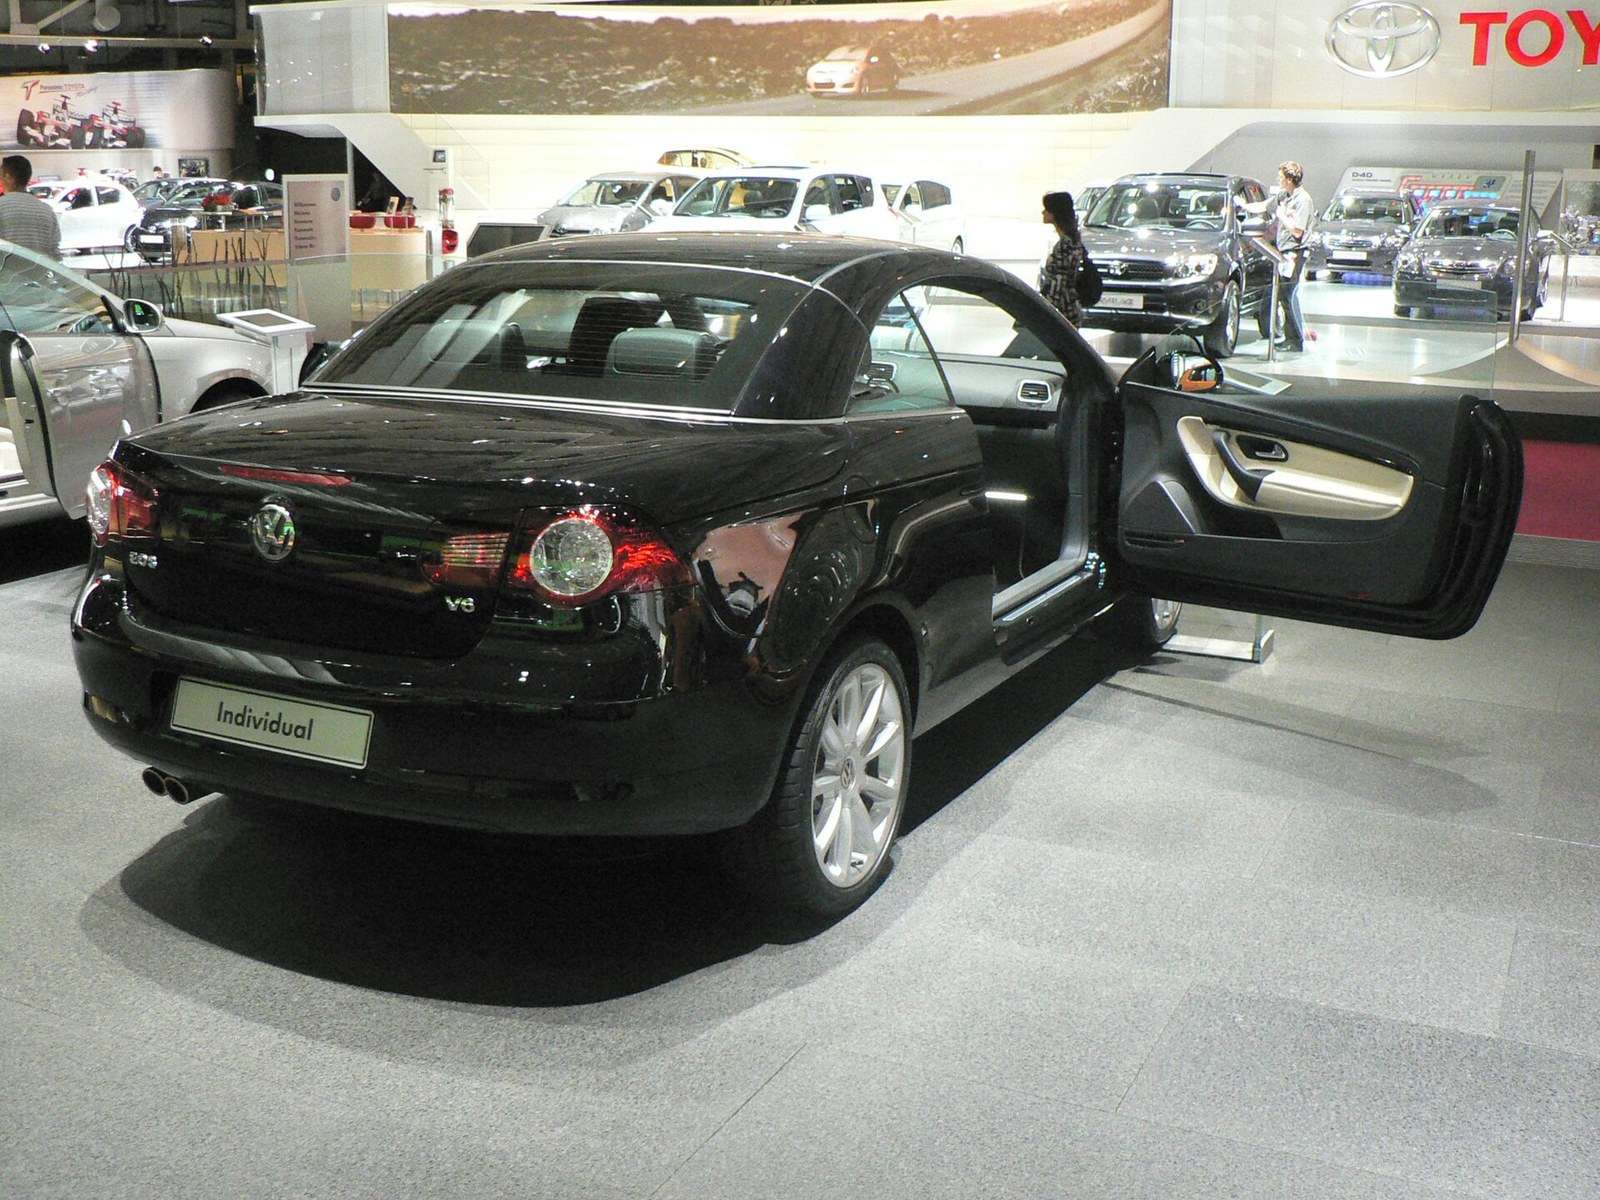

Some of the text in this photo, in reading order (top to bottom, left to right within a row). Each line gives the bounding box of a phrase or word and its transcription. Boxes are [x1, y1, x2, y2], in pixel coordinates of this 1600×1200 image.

[1459, 10, 1600, 67] TOY
[444, 596, 476, 613] V6
[217, 701, 314, 740] Individual
